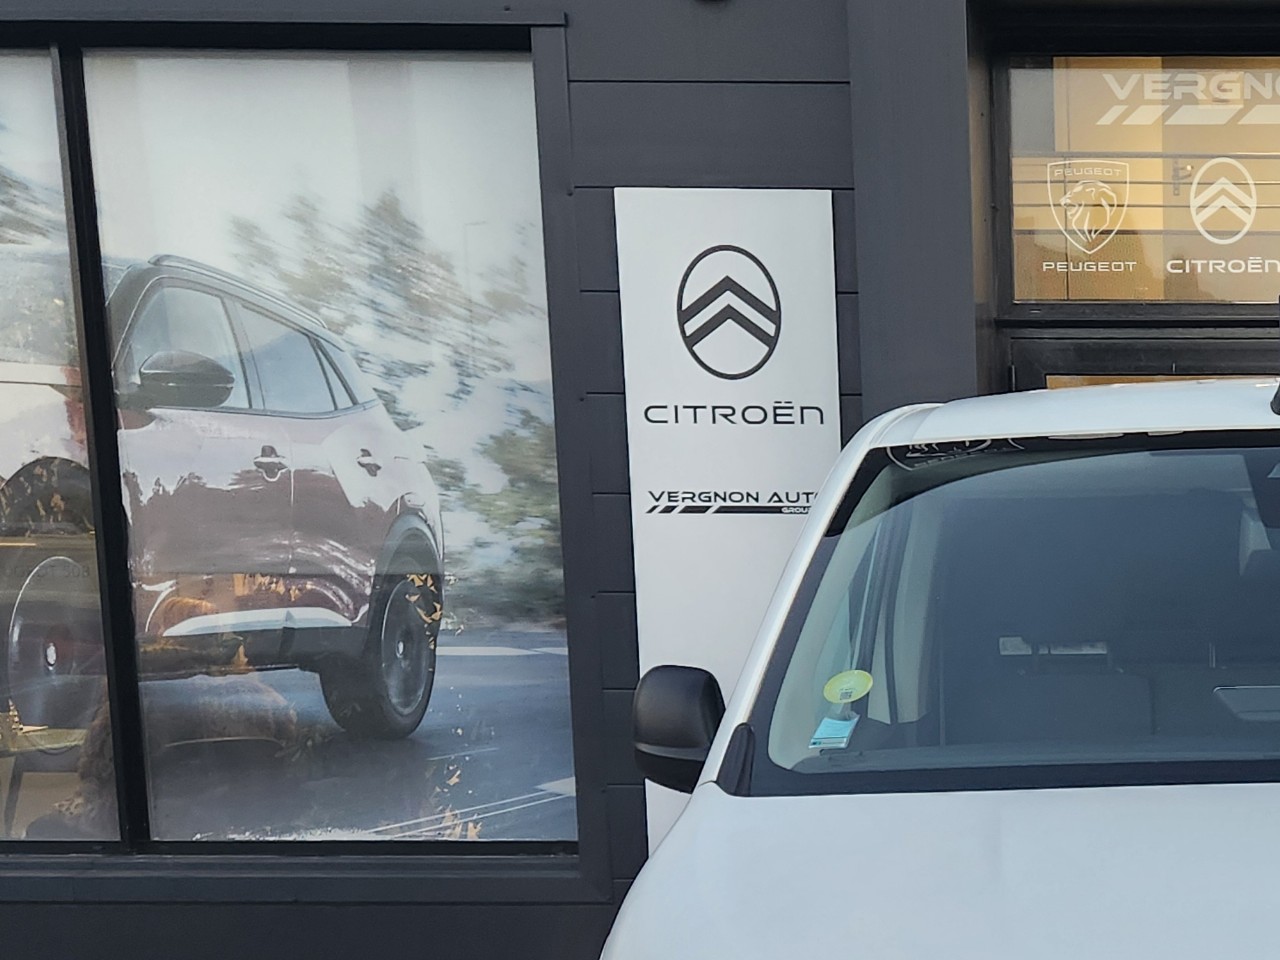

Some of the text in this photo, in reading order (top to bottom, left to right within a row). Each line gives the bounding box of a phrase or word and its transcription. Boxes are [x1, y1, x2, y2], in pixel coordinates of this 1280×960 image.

[1054, 167, 1122, 177] PEUGEOT
[1042, 261, 1137, 272] PEUGEOT
[648, 490, 819, 504] VERGNON AUT
